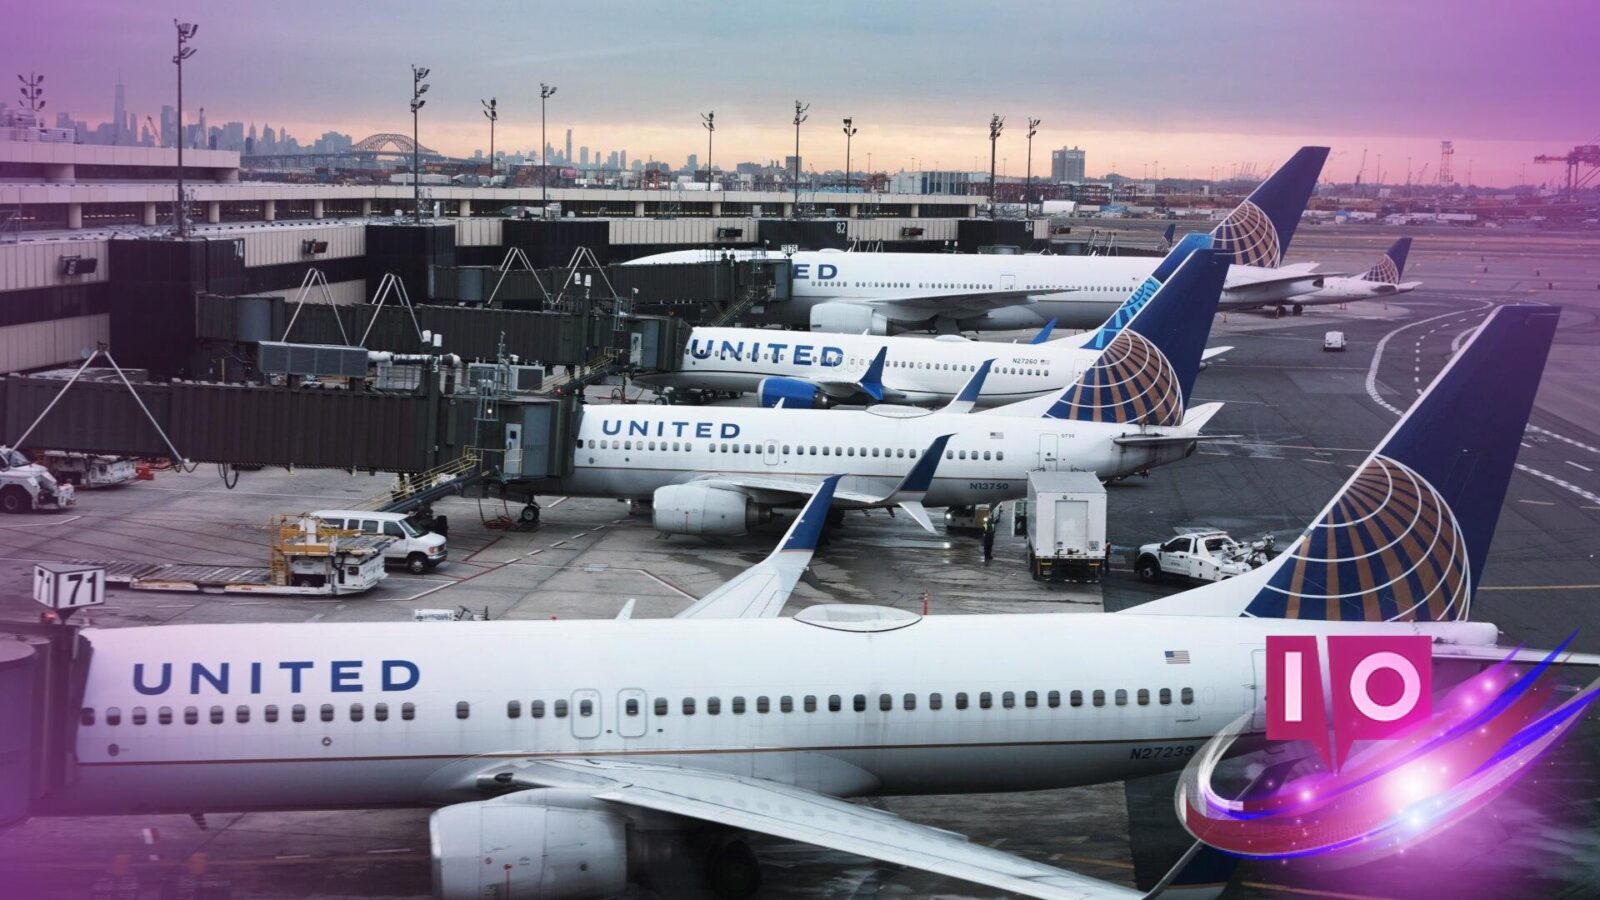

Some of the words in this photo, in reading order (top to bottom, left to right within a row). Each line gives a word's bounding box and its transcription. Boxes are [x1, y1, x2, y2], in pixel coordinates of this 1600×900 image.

[836, 222, 846, 234] 82
[793, 263, 838, 280] ED
[691, 339, 844, 367] UNITED
[602, 419, 741, 439] UNITED
[970, 482, 1009, 490] N13750
[67, 571, 97, 606] 71
[132, 659, 420, 696] UNITED
[1130, 745, 1196, 760] N27239
